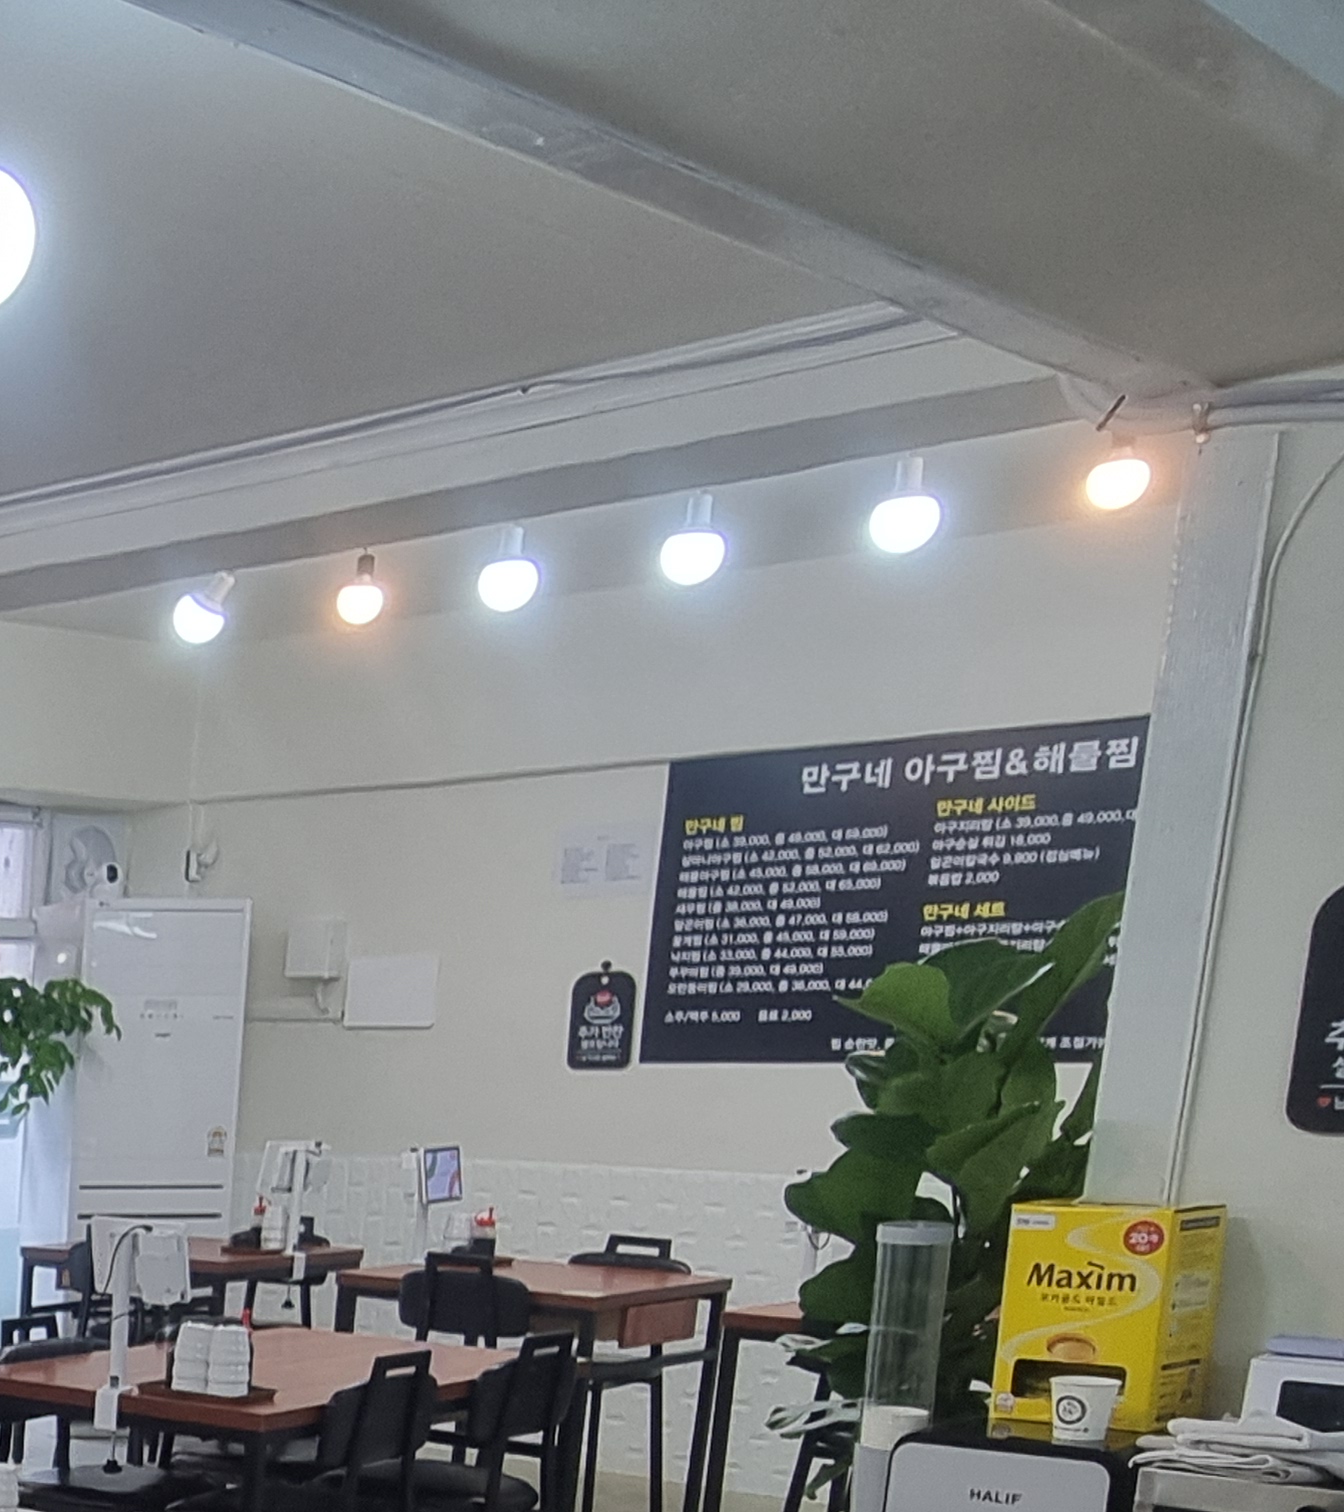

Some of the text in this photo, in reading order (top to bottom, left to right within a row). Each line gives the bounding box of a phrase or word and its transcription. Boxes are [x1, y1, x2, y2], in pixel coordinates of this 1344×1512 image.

[802, 736, 1139, 794] 만구네 아구찜&해물찜
[937, 794, 1036, 817] 만구네 사이드
[685, 816, 726, 836] 만구네
[923, 901, 1006, 921] 만구네 세트
[1026, 1261, 1138, 1292] Maxim
[970, 1488, 1022, 1505] HALIF
